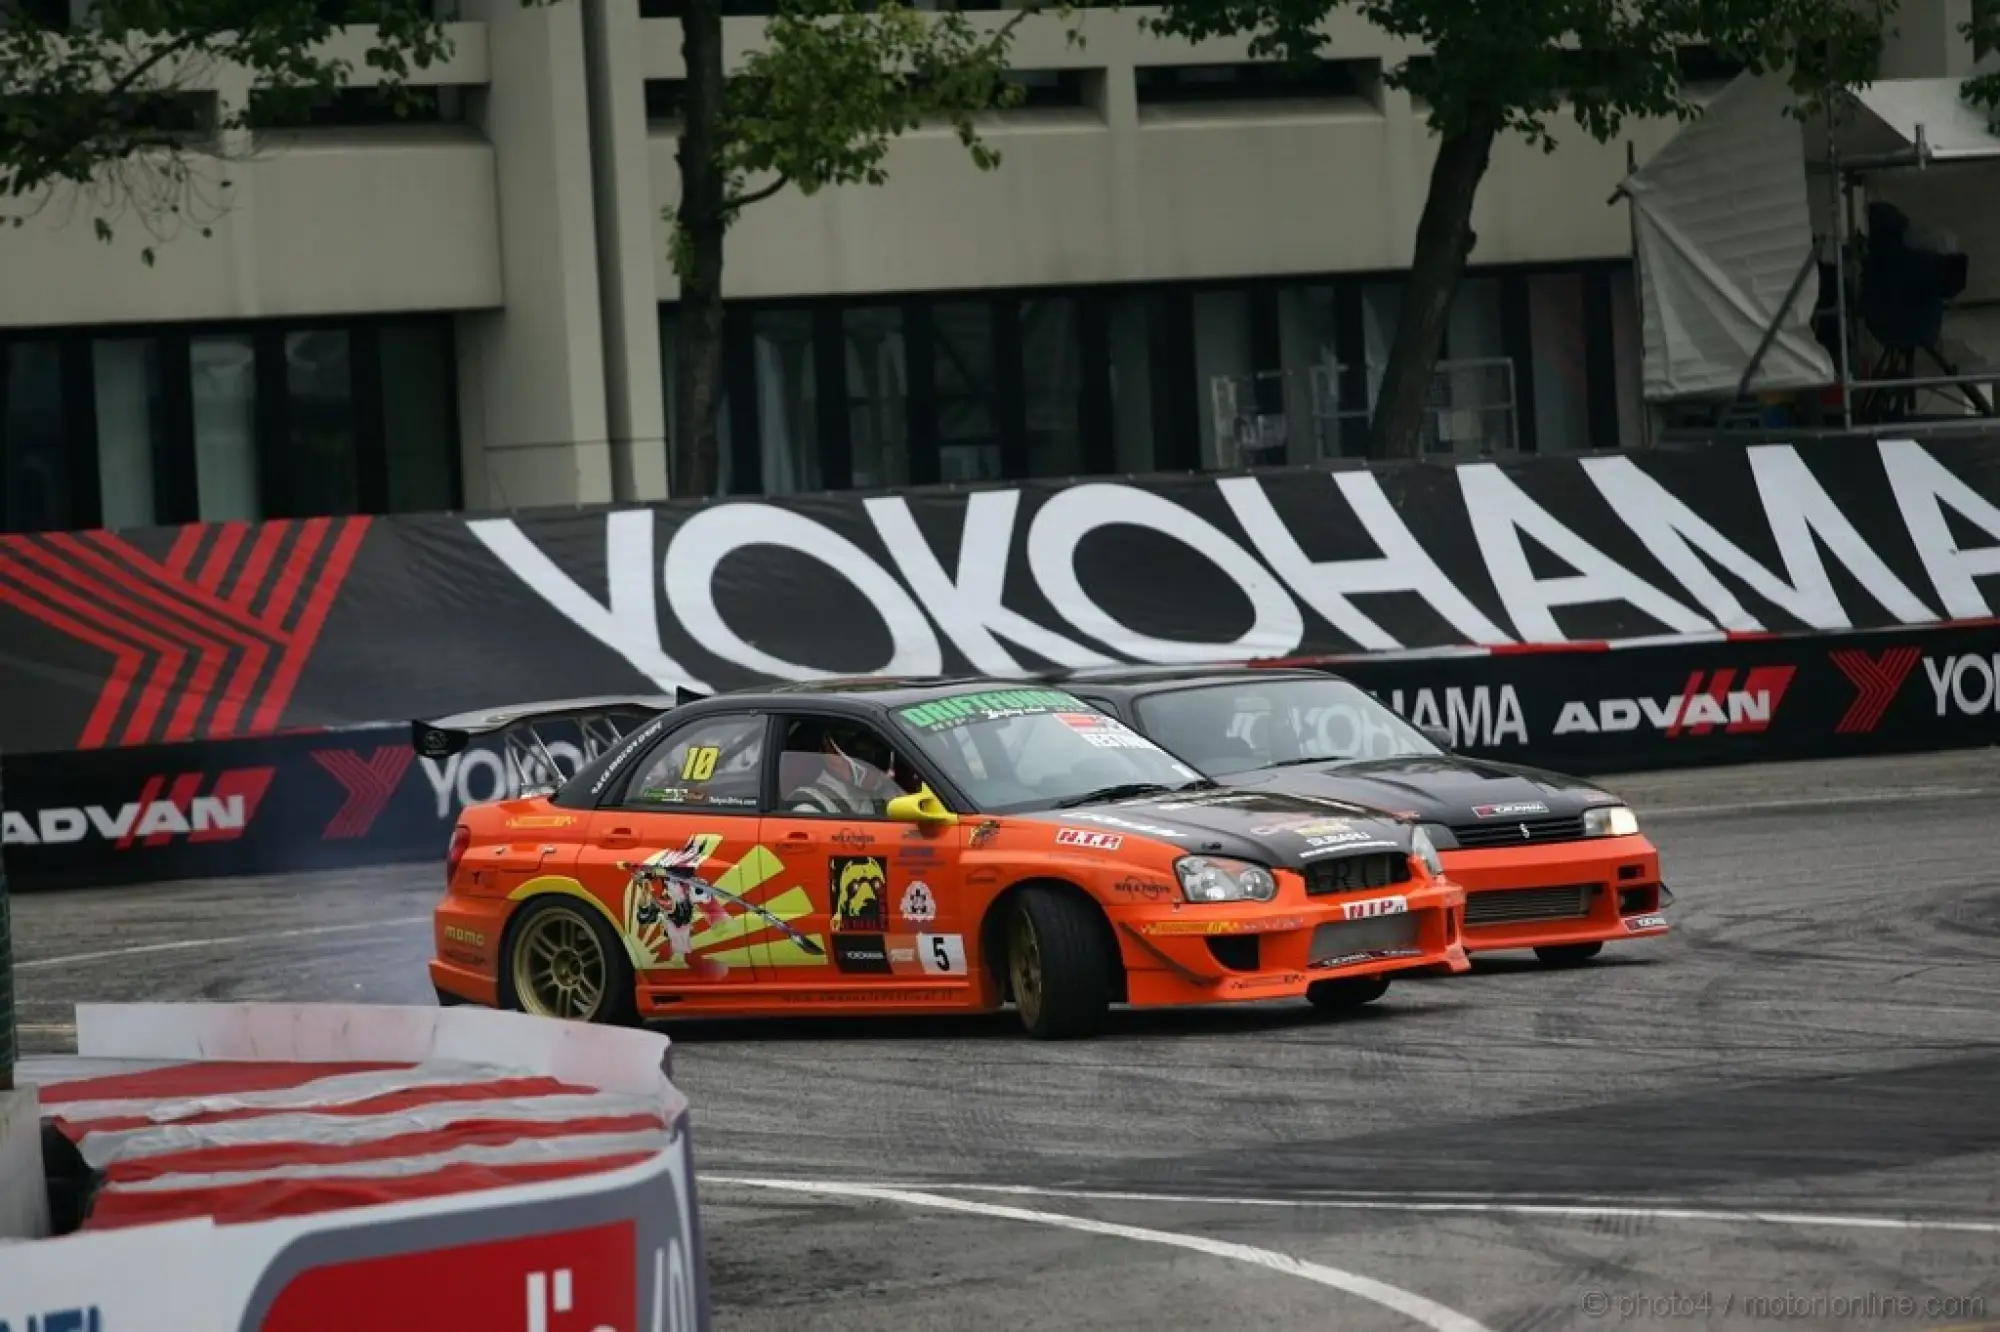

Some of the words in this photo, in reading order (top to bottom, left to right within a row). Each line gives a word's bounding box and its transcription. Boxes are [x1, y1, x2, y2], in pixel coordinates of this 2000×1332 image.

[464, 438, 2000, 694] YOKOHAMA
[1552, 689, 1771, 735] ADVAN
[681, 746, 721, 781] 10
[2, 795, 245, 843] ADVAN
[932, 937, 950, 971] 5
